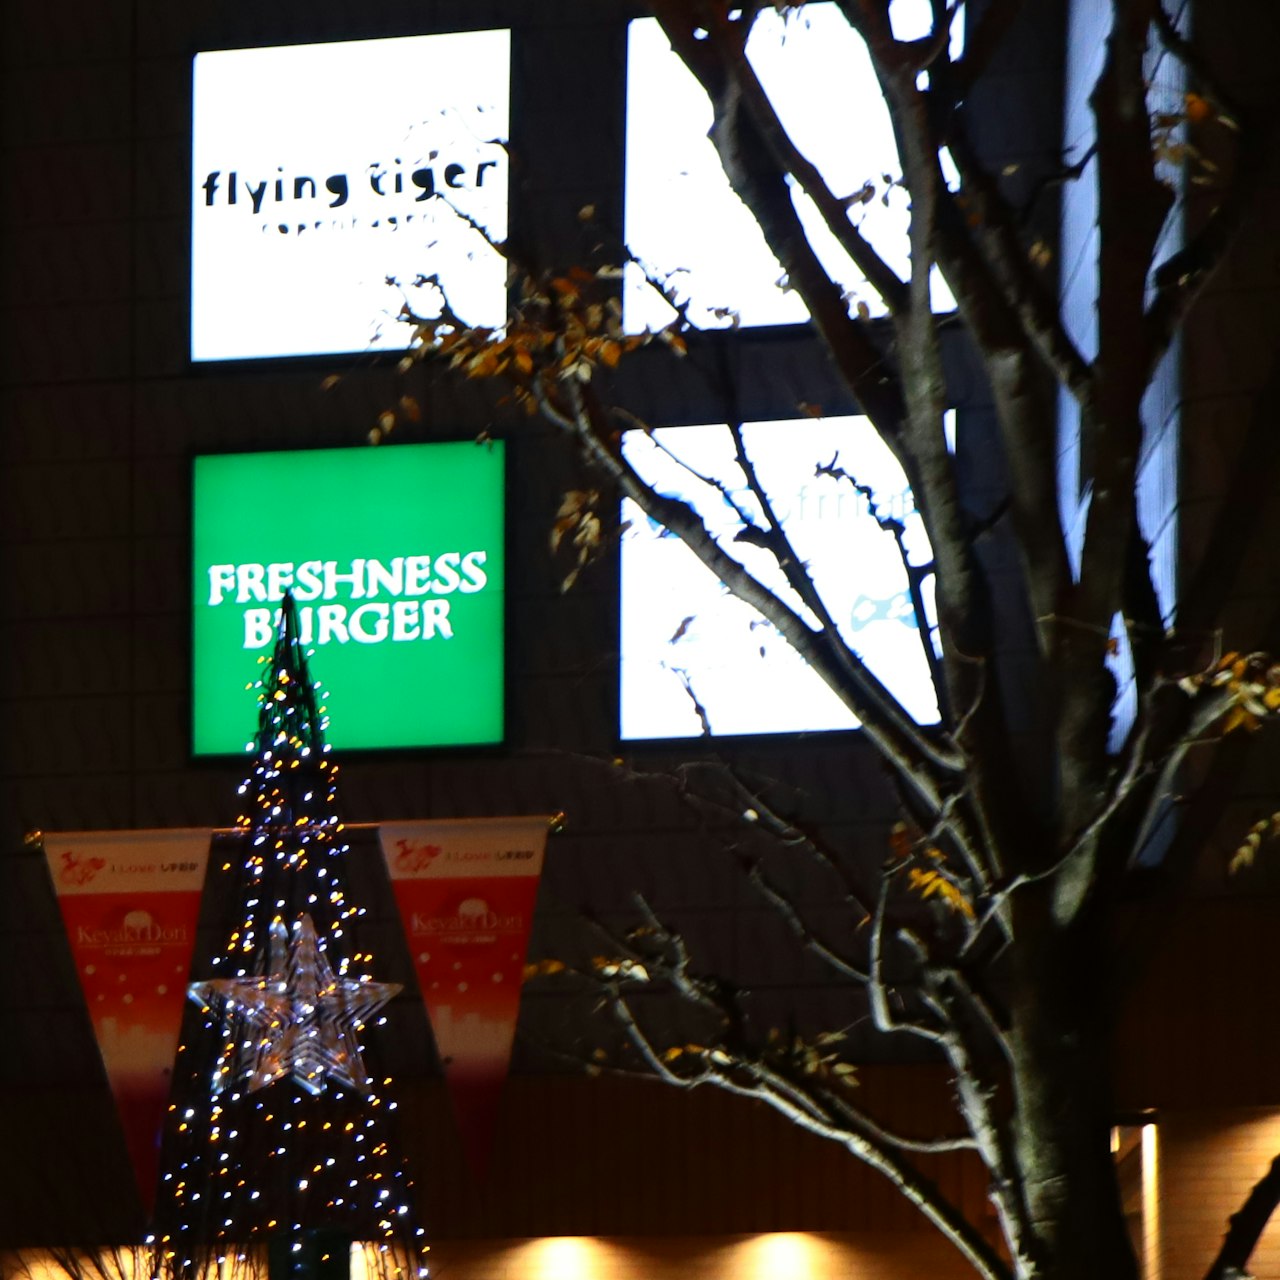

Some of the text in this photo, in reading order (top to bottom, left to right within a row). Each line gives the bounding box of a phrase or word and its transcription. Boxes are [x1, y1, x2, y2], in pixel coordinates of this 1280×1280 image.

[202, 158, 497, 214] flying tiger
[208, 550, 488, 606] FRESHNESS
